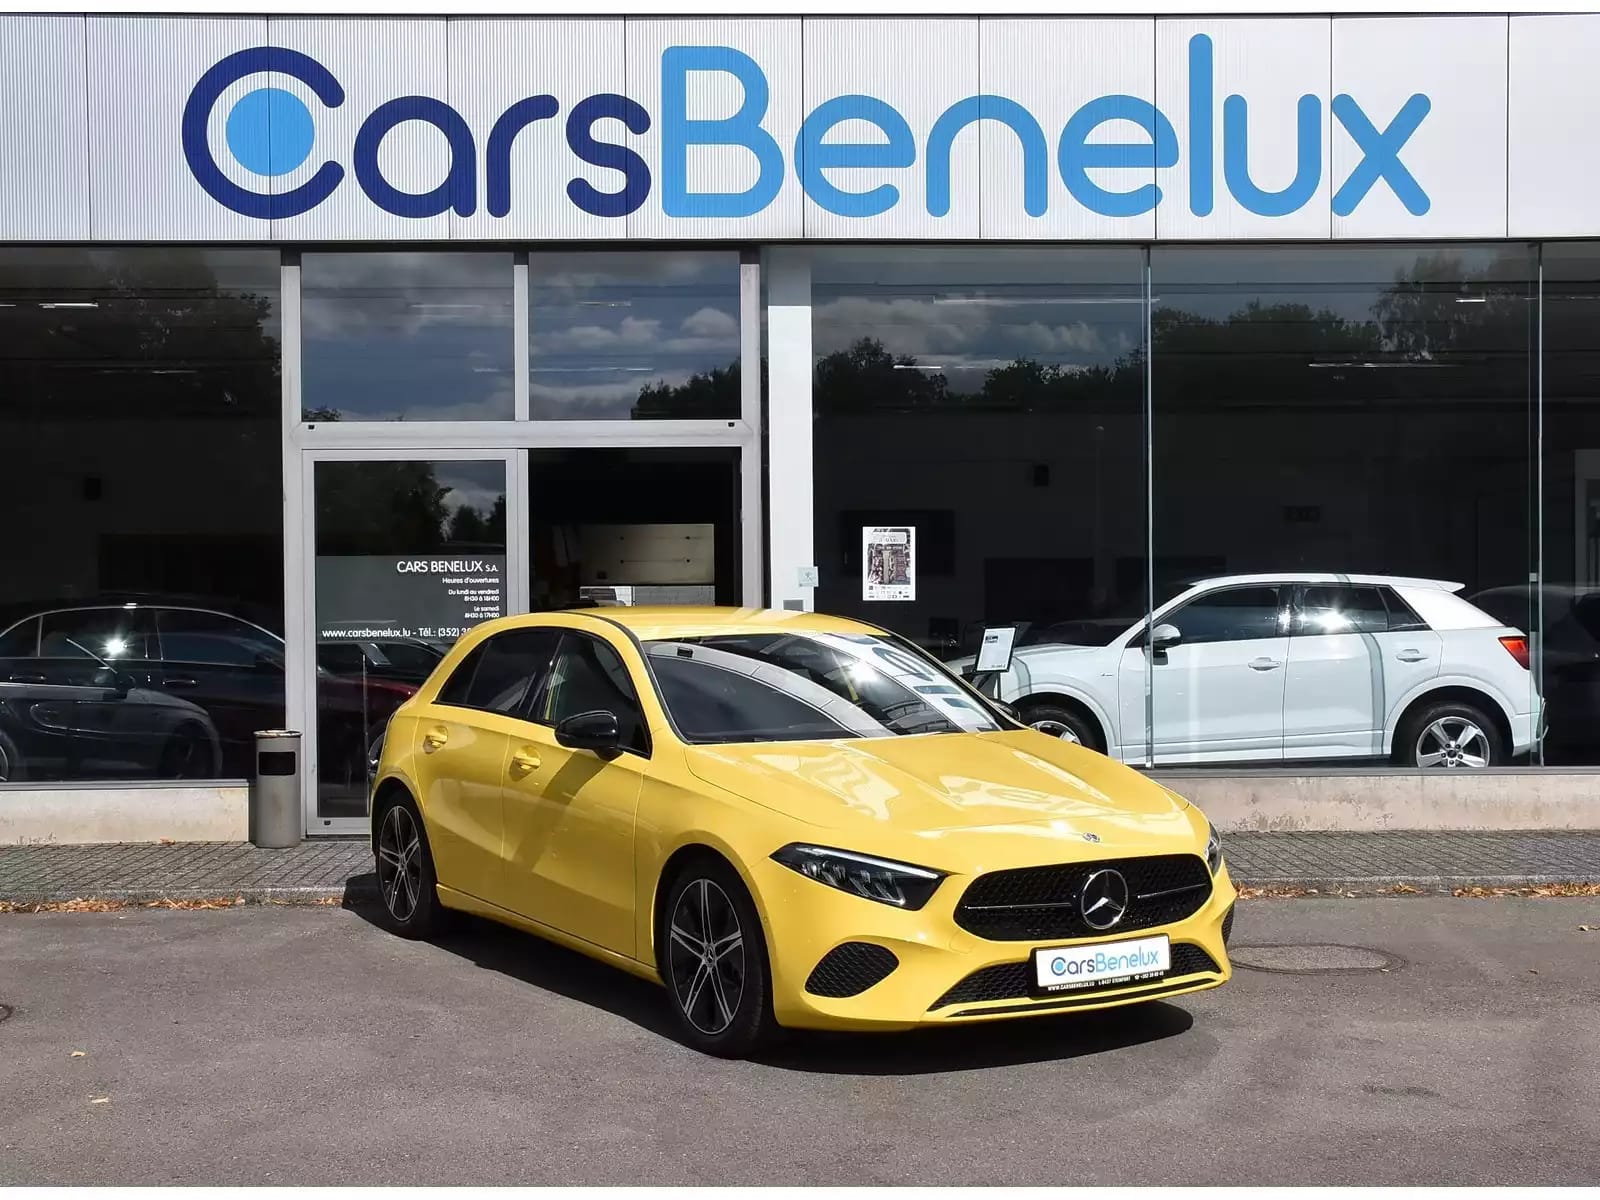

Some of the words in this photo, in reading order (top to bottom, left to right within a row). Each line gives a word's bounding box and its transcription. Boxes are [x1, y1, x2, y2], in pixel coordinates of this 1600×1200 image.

[182, 33, 1431, 219] CarsBenelux
[396, 560, 429, 573] CARS
[430, 560, 483, 573] BENELUX
[485, 564, 499, 572] S.A.
[322, 627, 411, 638] www.carsbenelux.lu
[438, 627, 460, 638] (352)
[1050, 945, 1159, 977] CarsBenelux
